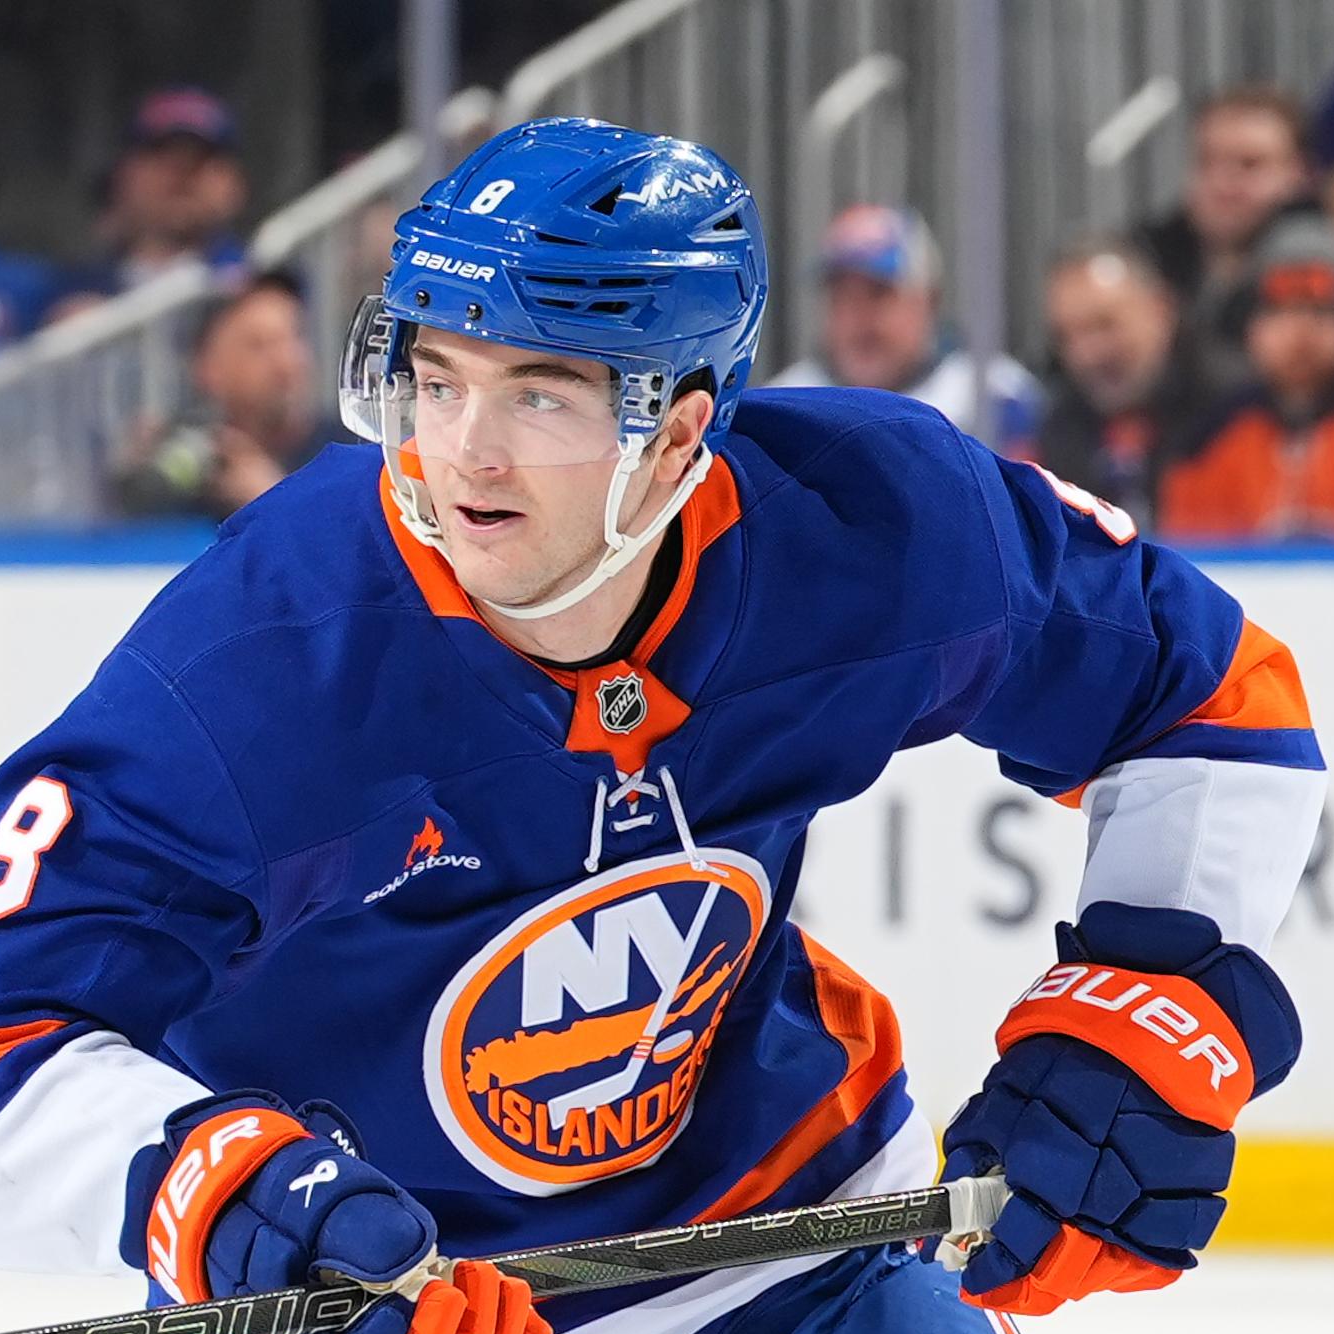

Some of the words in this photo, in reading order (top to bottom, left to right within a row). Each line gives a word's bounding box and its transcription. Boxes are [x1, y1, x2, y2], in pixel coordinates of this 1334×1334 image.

[469, 179, 515, 215] 8
[610, 688, 635, 723] NHL
[363, 871, 409, 904] solo
[411, 854, 482, 877] stove
[521, 882, 721, 1040] NY
[1012, 966, 1240, 1092] AUER
[151, 1115, 264, 1305] UER
